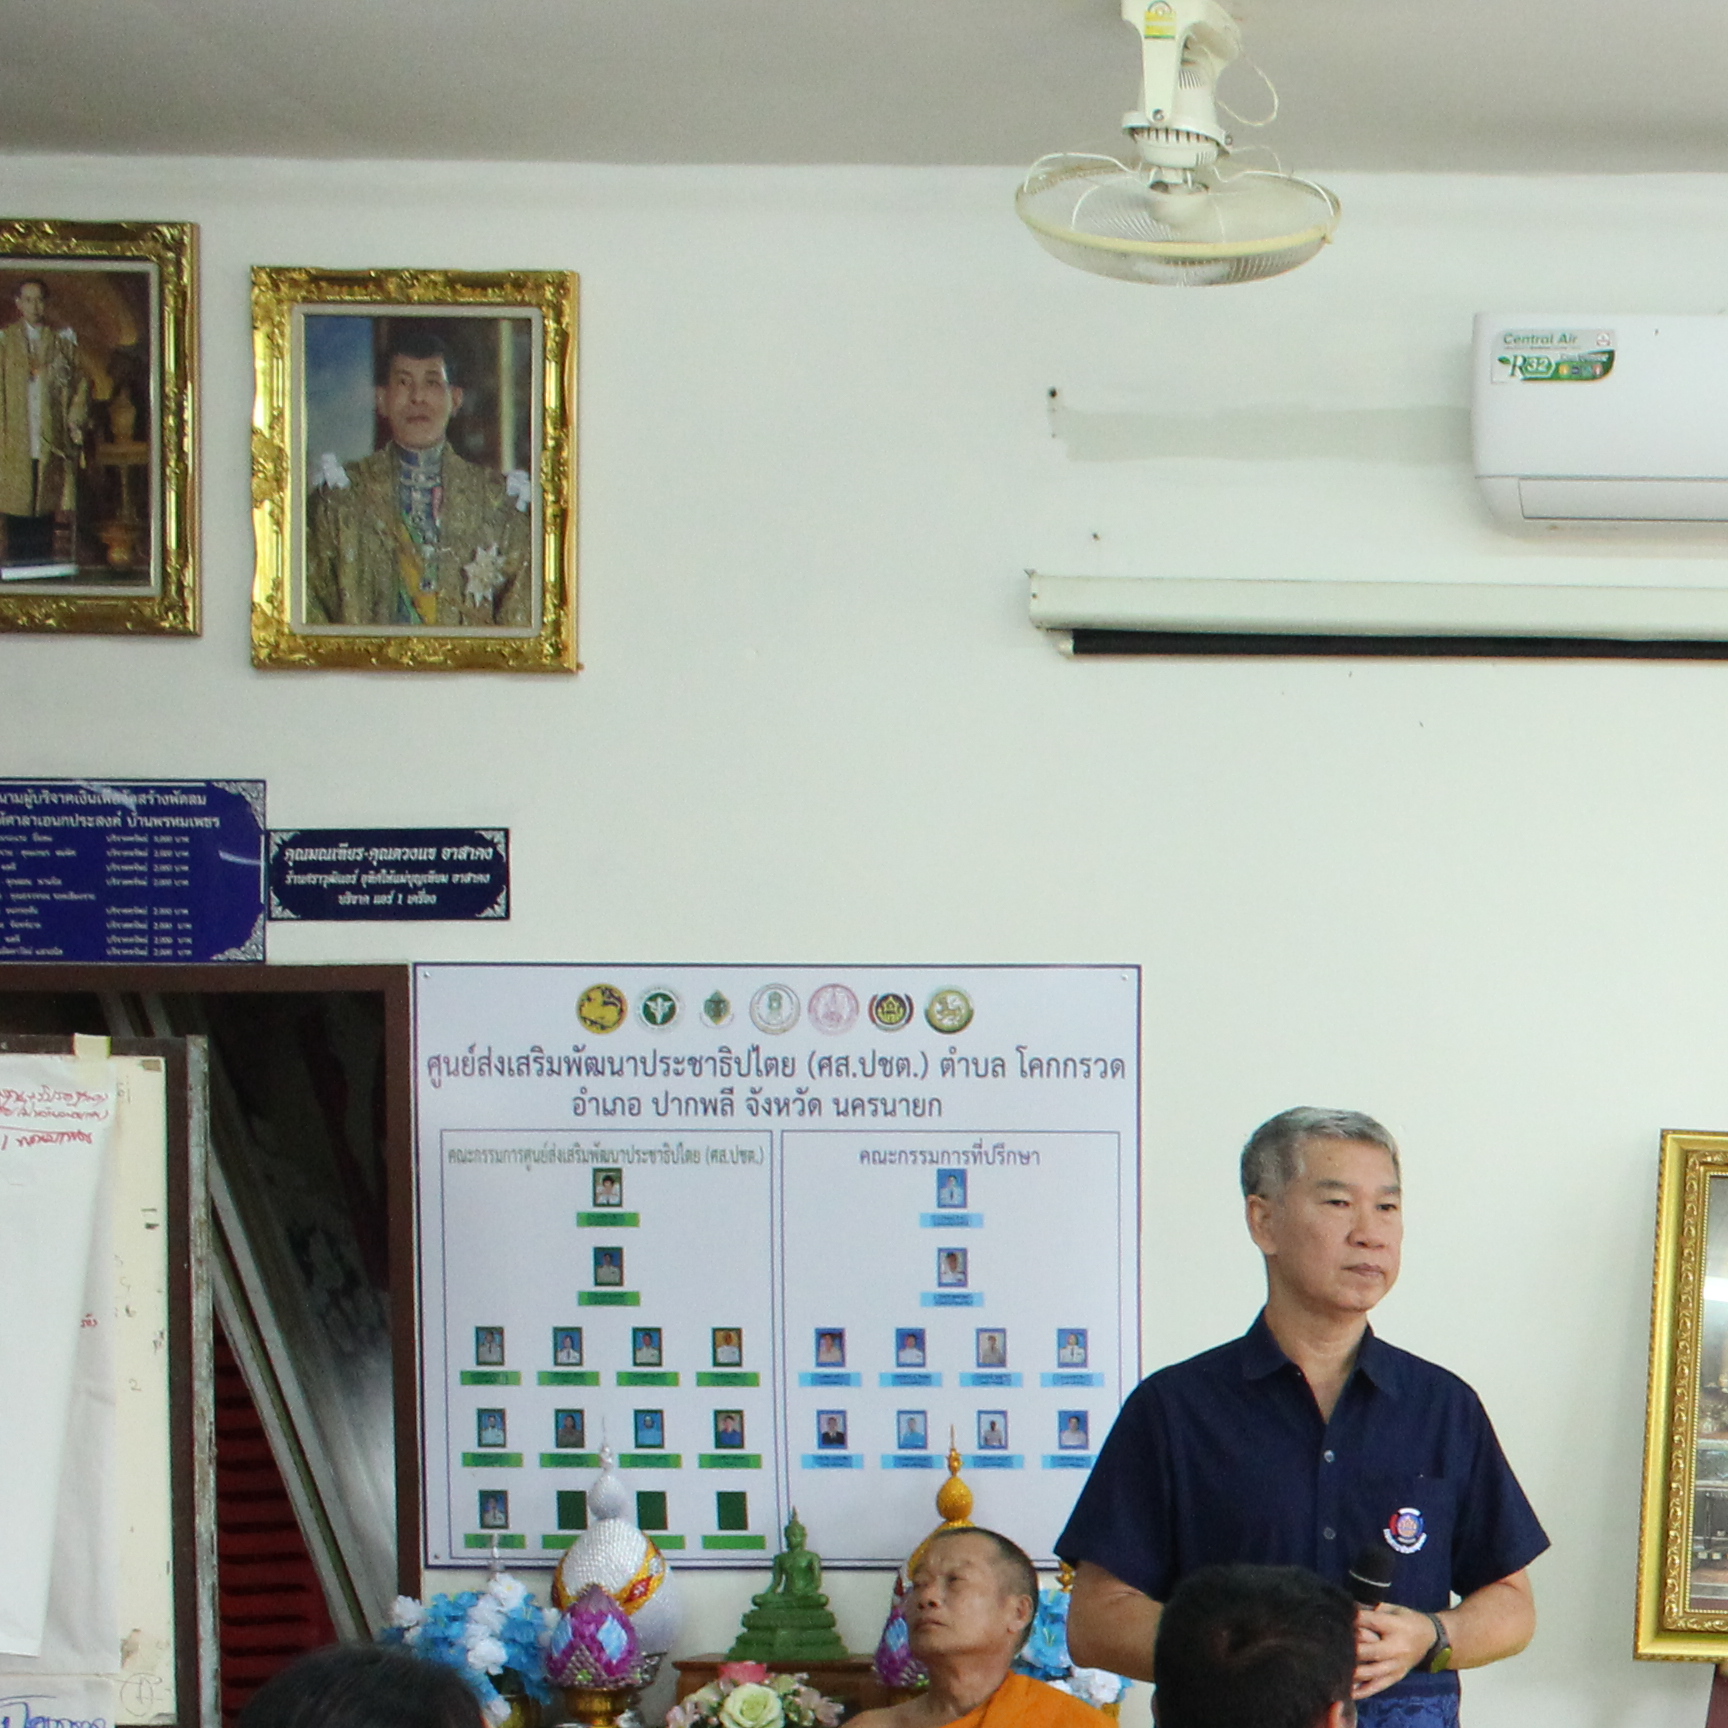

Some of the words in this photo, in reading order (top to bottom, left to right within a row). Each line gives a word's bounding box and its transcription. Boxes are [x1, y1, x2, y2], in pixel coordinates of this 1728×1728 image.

[1503, 333, 1553, 345] Central
[1557, 333, 1578, 344] Air
[426, 1043, 796, 1089] ศูนย์ส่งเสริมพัฒนาประชาธิปไตย
[806, 1049, 930, 1080] (ศส.ปชต.)
[940, 1045, 1007, 1080] ตำบล
[1014, 1044, 1126, 1080] โคกกรวด
[571, 1086, 642, 1118] อำเภอ
[651, 1087, 736, 1118] ปากพลี
[745, 1086, 823, 1119] จังหวัด
[832, 1096, 943, 1119] นครนายก
[858, 1138, 1041, 1167] คณะกรรมการที่ปรึกษา
